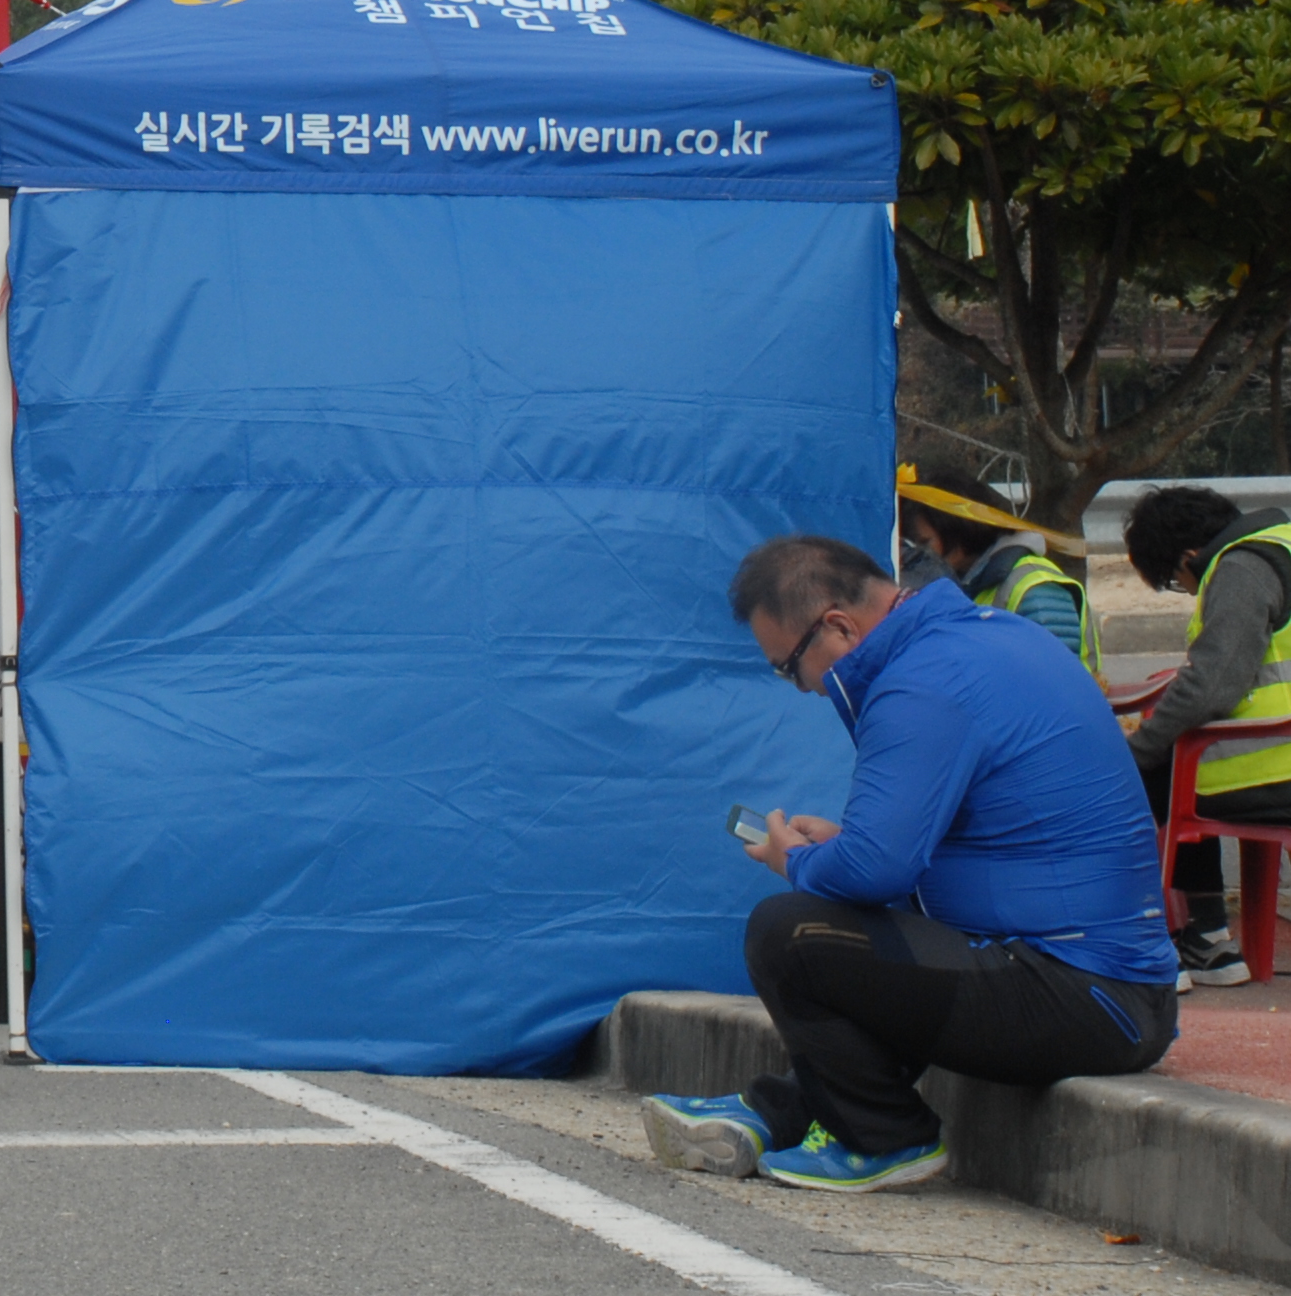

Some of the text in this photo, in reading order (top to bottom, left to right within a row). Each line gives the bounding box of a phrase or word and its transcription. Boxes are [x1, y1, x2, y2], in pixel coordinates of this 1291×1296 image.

[134, 111, 768, 156] 실시간 기록검색 www.liverun.co.kr
